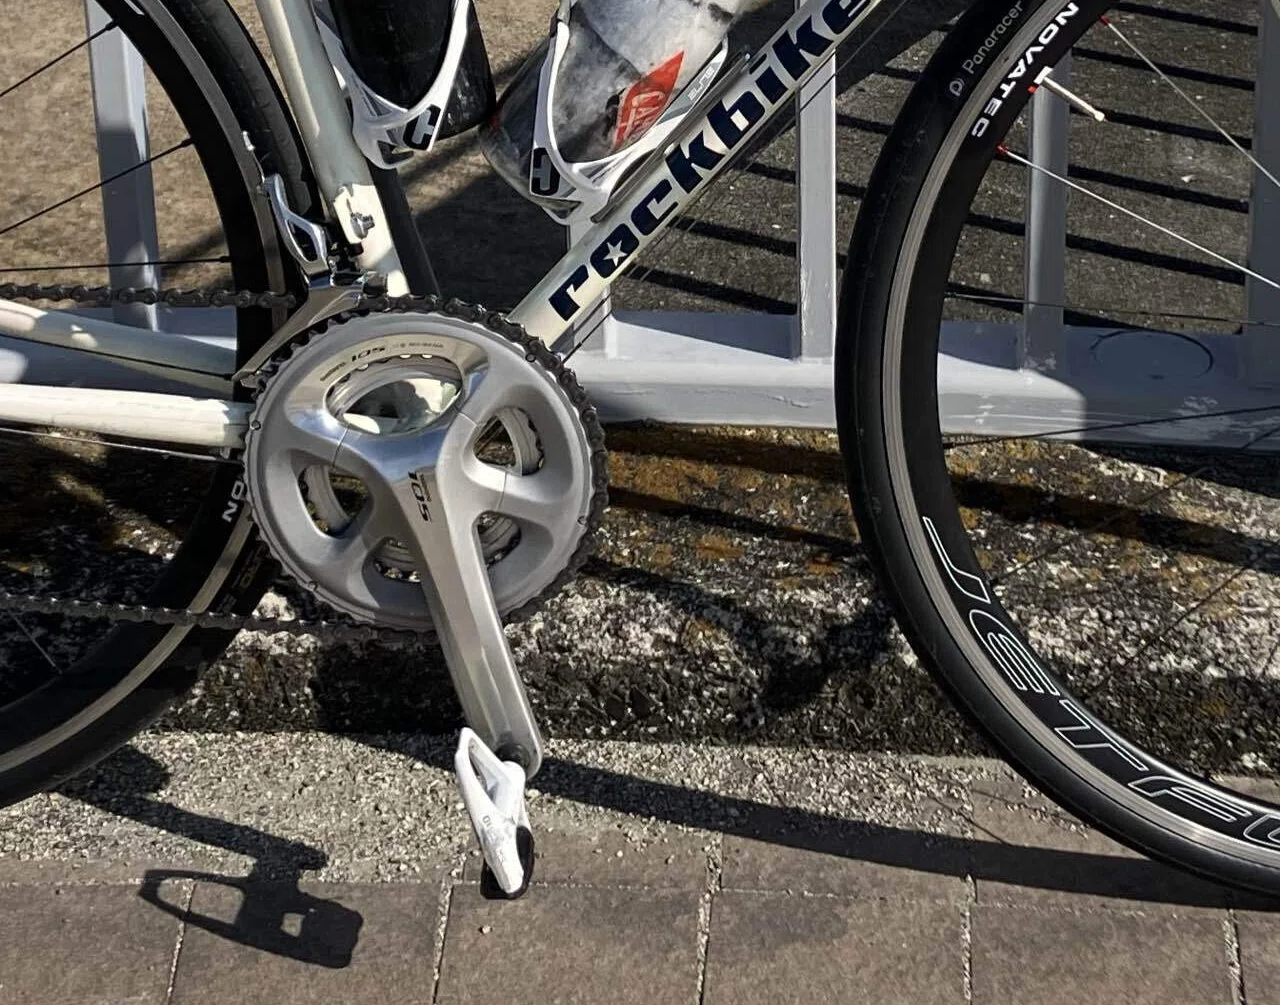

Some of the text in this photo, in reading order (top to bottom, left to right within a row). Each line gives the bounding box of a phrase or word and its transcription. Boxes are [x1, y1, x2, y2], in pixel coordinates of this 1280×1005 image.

[961, 0, 1023, 75] Panaracer
[970, 2, 1080, 138] NOVATEC
[407, 470, 432, 523] 105
